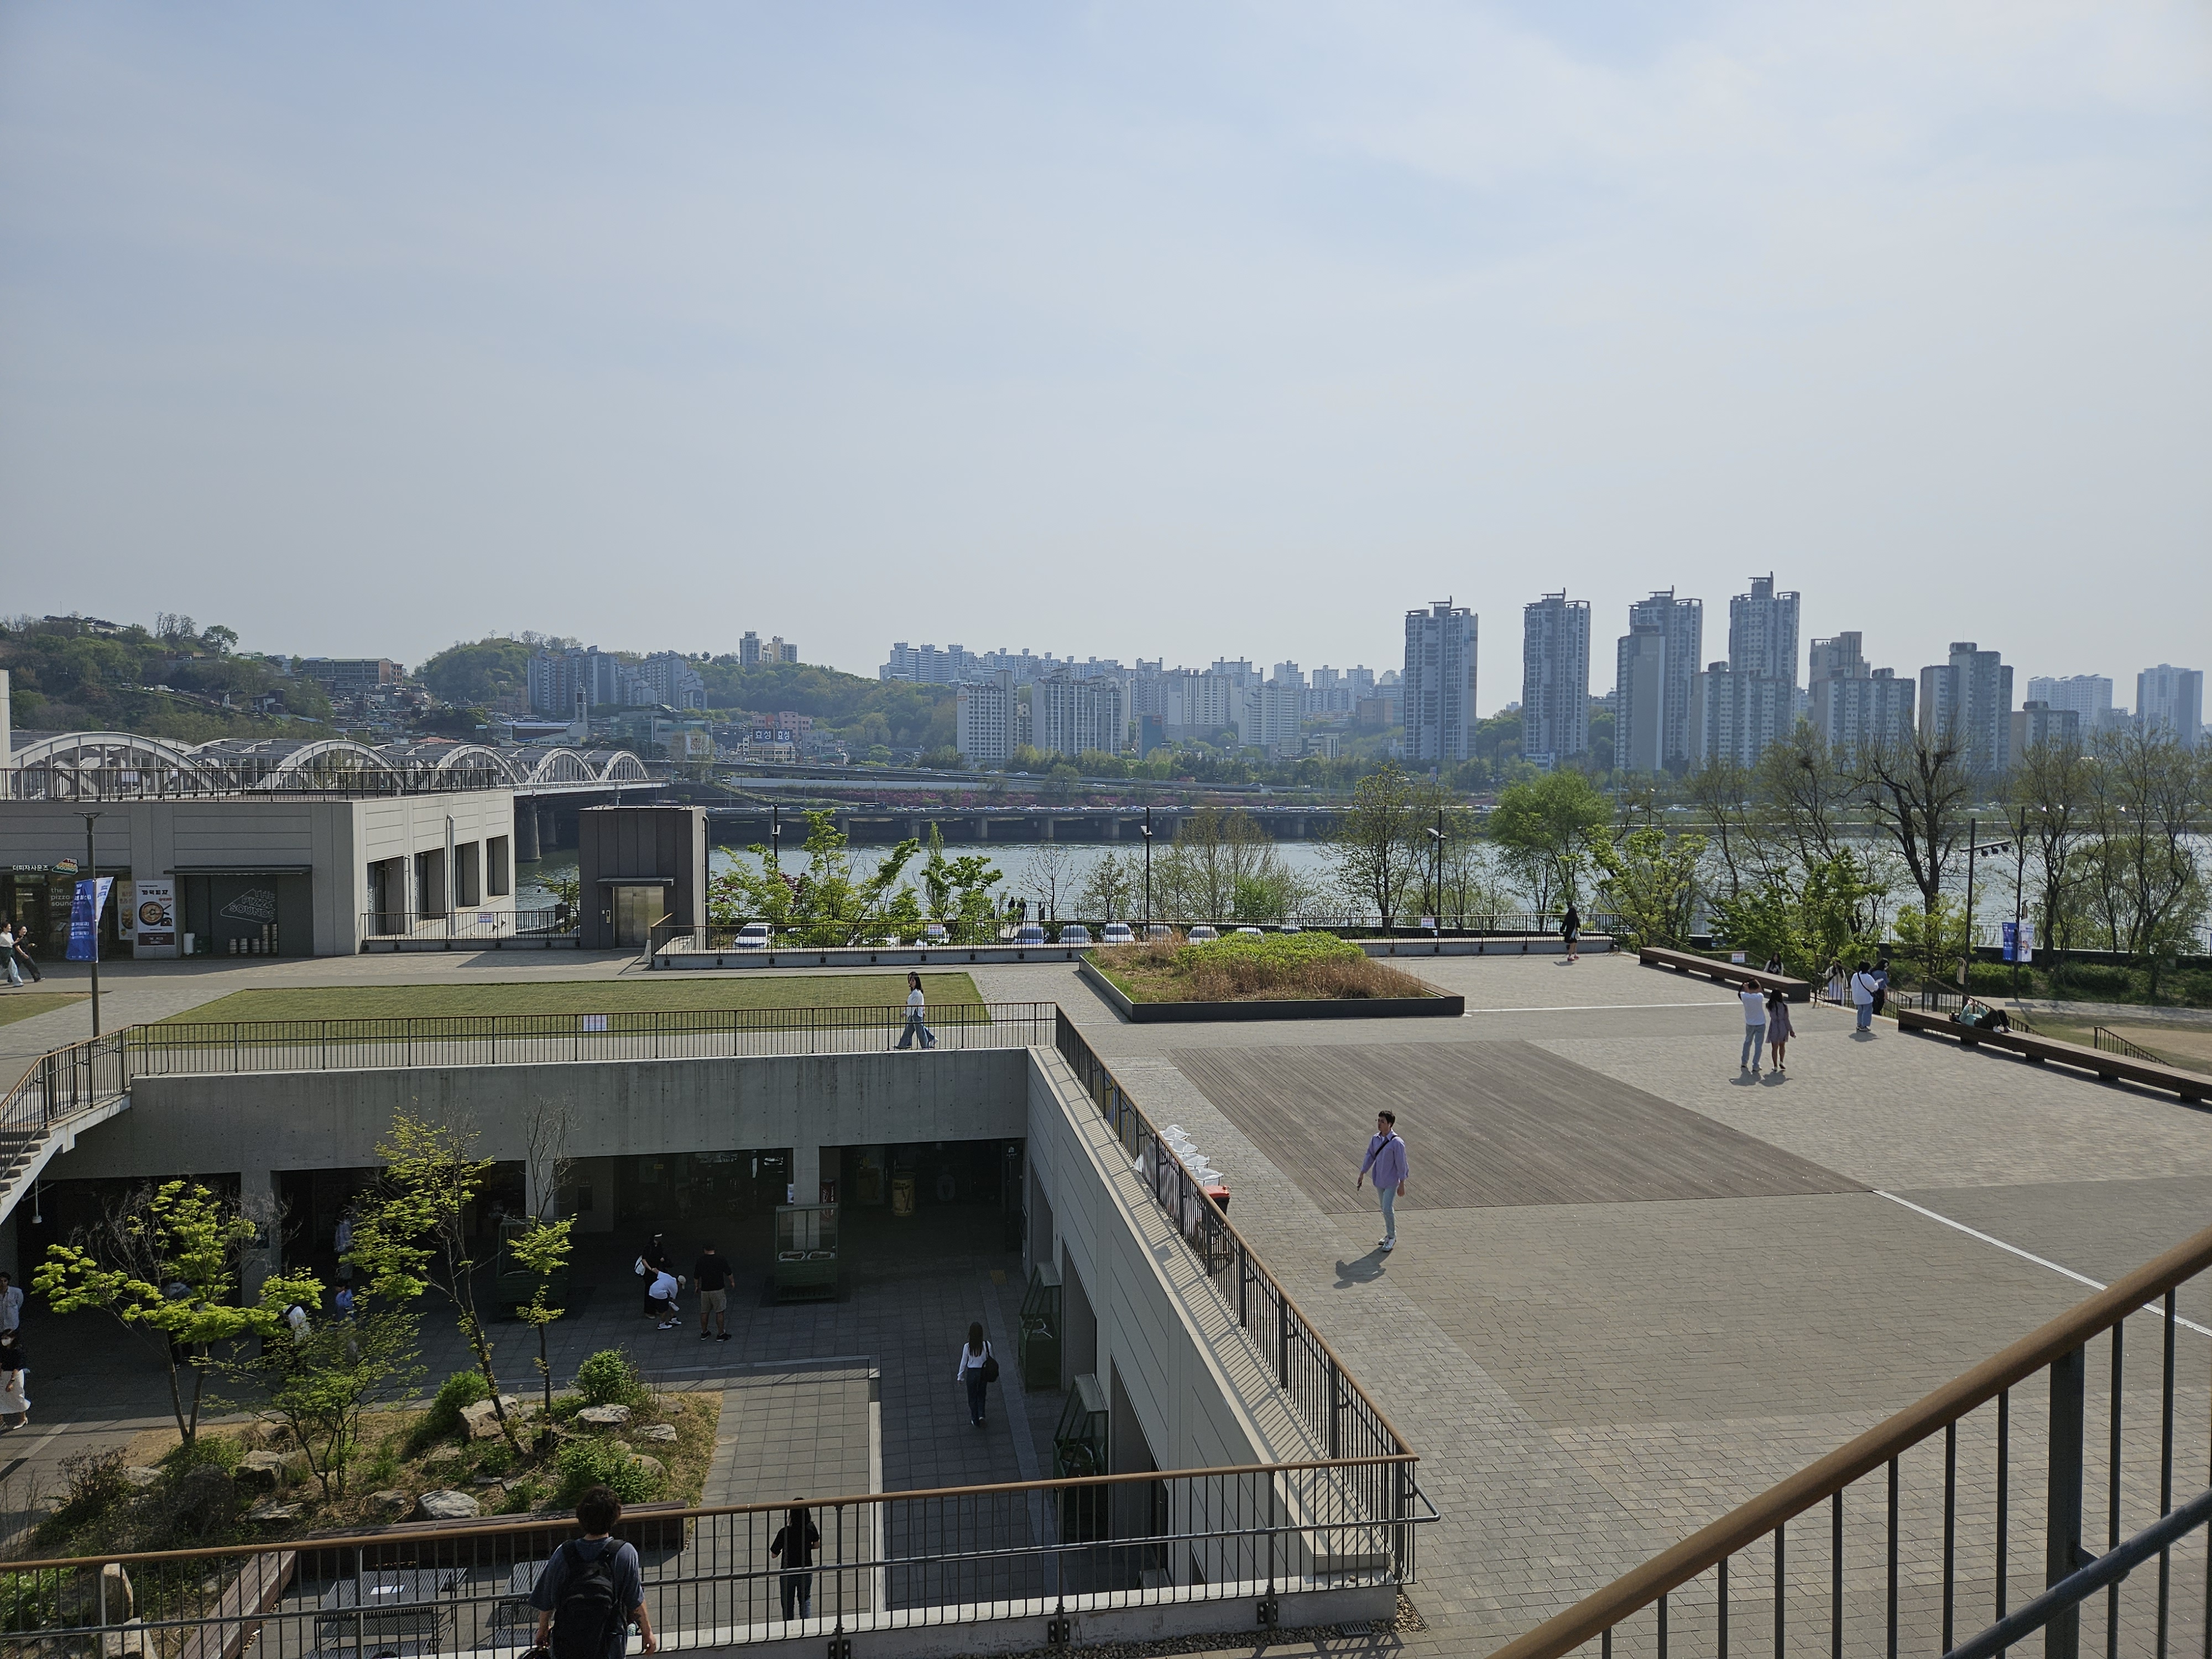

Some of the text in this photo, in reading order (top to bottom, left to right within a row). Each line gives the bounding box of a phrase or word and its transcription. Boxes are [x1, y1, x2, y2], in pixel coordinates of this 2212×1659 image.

[755, 731, 771, 739] 효성
[778, 730, 790, 740] 효성
[254, 890, 275, 899] THE
[242, 897, 275, 908] PIZZA
[229, 903, 275, 918] SOUNDS
